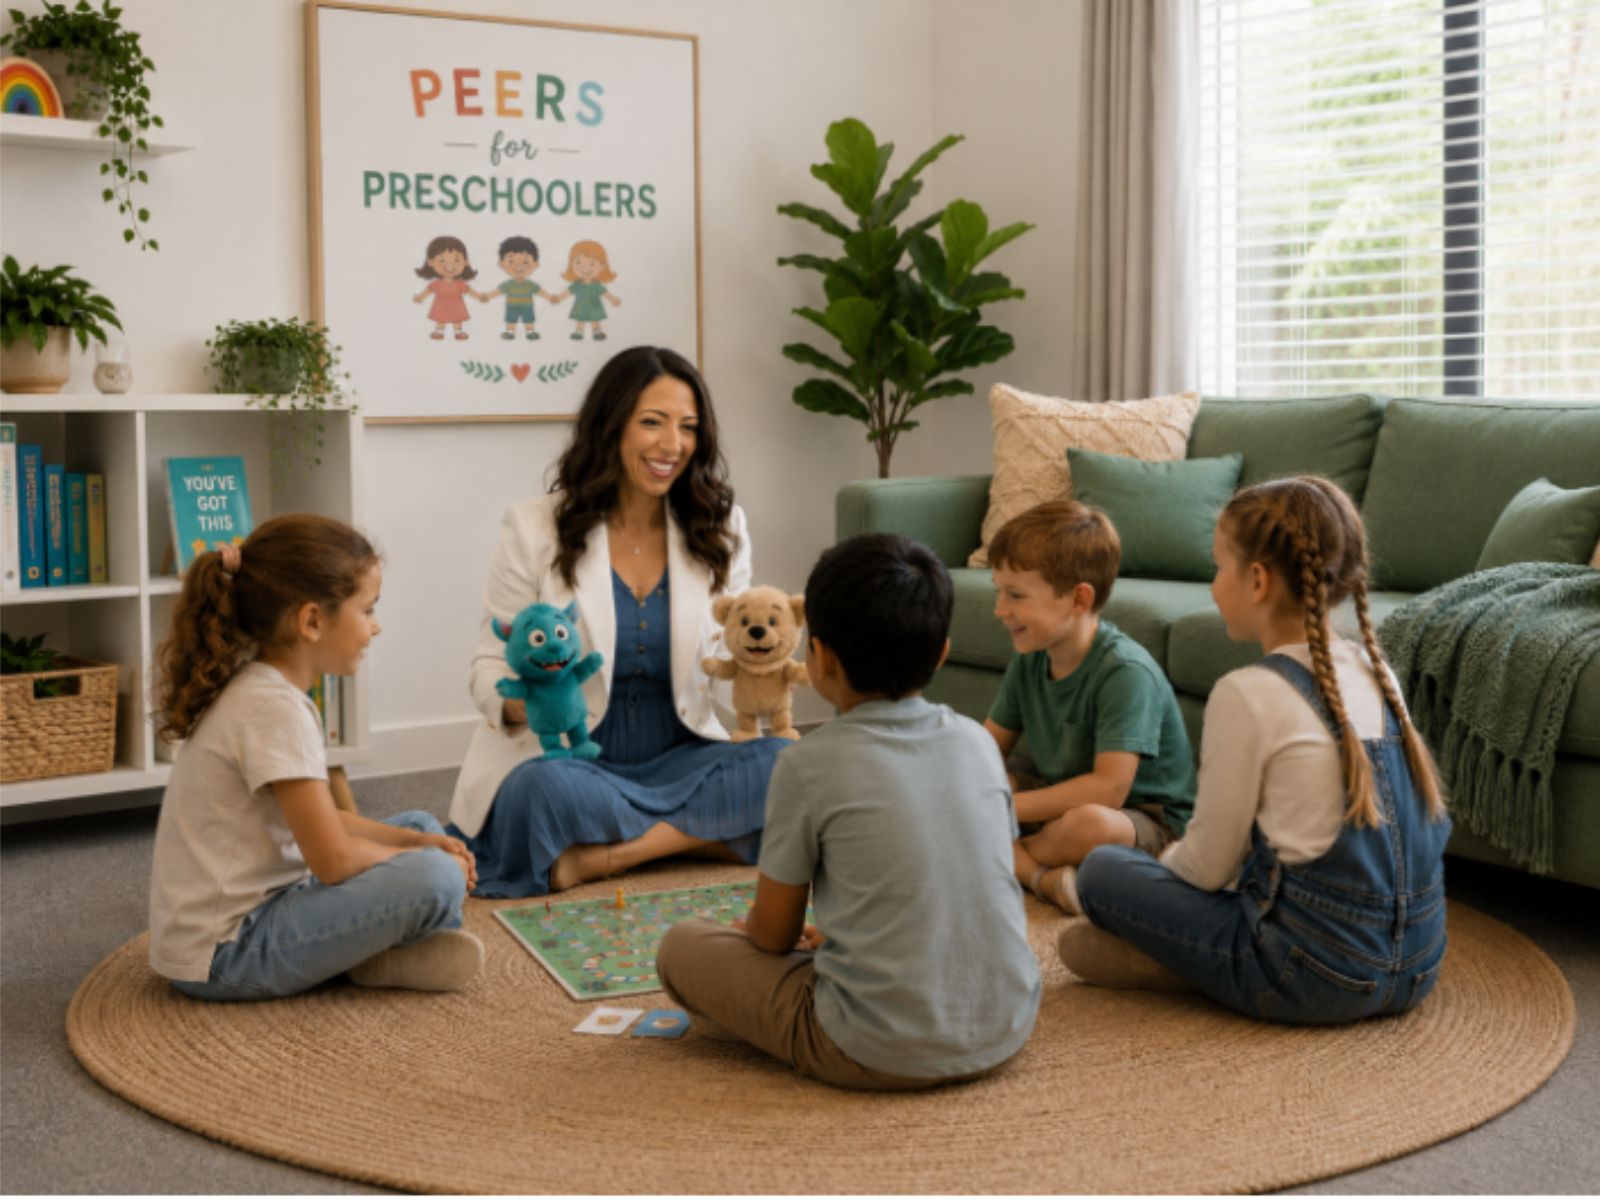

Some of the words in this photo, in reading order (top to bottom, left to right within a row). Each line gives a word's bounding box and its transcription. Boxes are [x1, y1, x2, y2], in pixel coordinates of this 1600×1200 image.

[409, 68, 605, 127] PEERS
[489, 130, 538, 167] for
[363, 170, 657, 219] PRESCHOOLERS
[183, 475, 237, 492] YOU'VE
[197, 495, 229, 512] GOT
[198, 514, 234, 532] THIS
